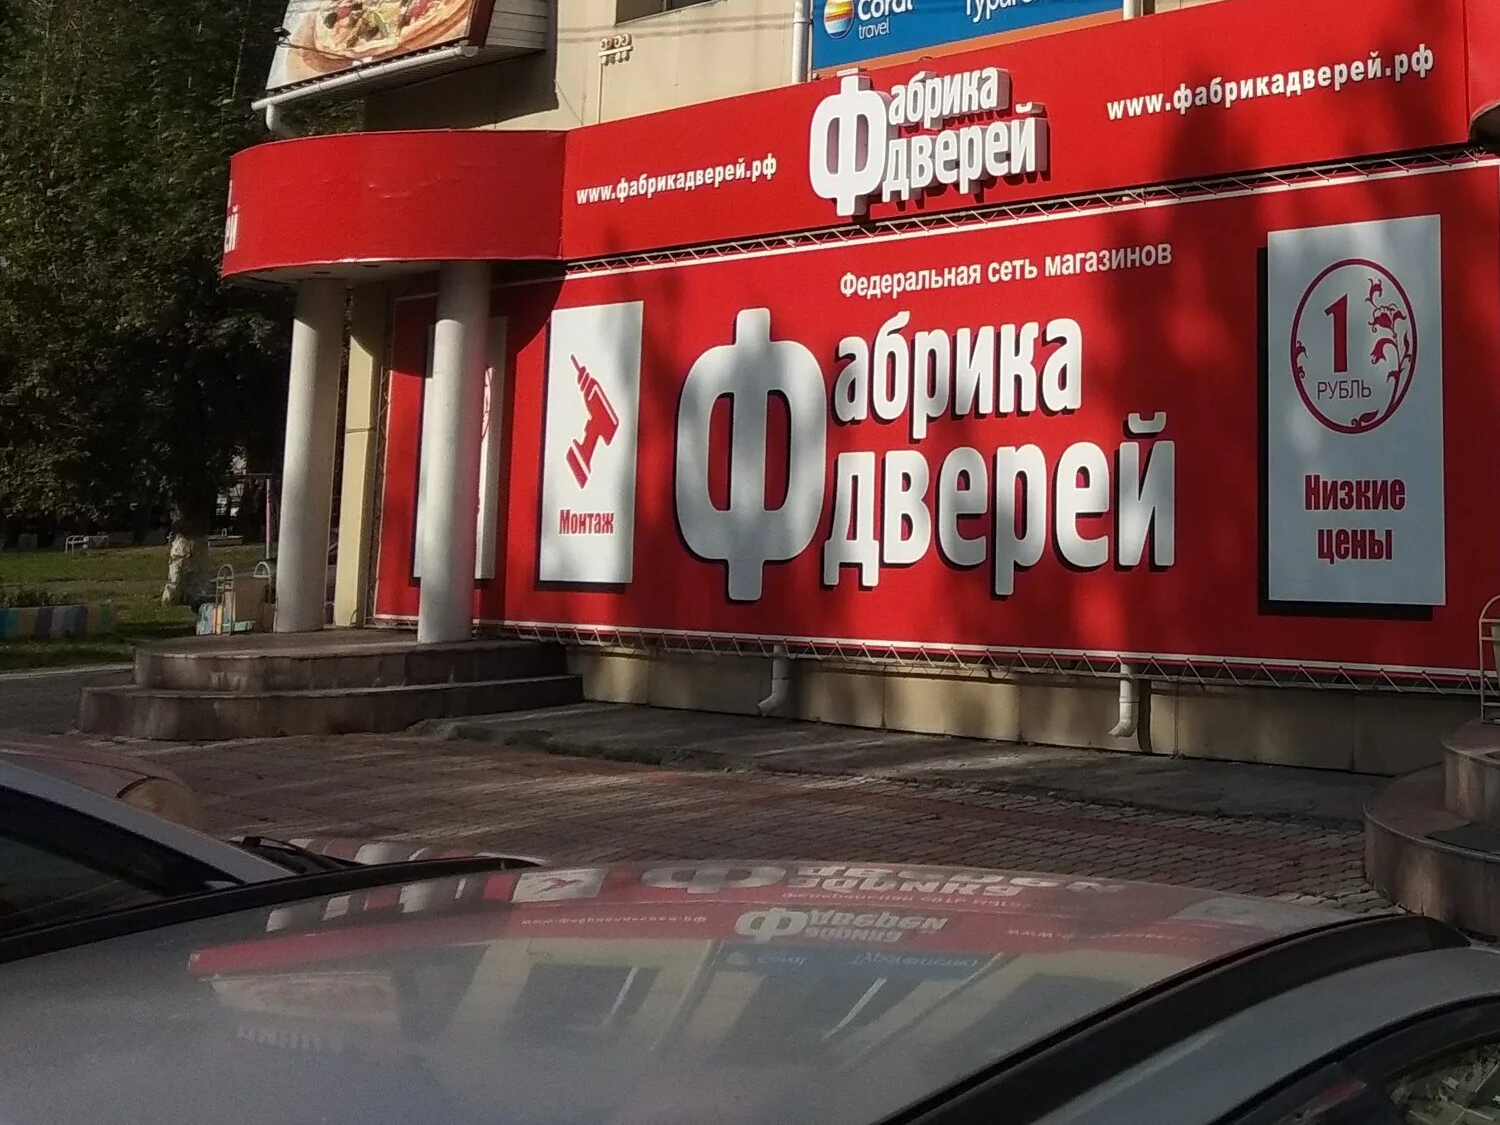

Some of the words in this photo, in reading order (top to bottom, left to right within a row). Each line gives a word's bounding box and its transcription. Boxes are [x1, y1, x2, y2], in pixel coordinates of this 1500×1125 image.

[858, 18, 891, 40] travel
[1107, 43, 1435, 120] www.фабрикадверей.рф
[809, 68, 1000, 217] Фабрика
[882, 102, 1038, 203] дверей
[576, 153, 777, 204] www.фабрикадверей.рф
[839, 263, 981, 300] Федеральная
[987, 258, 1039, 284] сеть
[1044, 242, 1173, 277] магазинов
[1324, 293, 1350, 374] 1
[1316, 379, 1373, 402] РУБЛЬ
[676, 307, 1083, 602] Фабрика
[558, 508, 615, 535] Монтаж
[822, 411, 1176, 597] дверей
[1304, 474, 1406, 512] Низкие
[1317, 528, 1393, 565] цены
